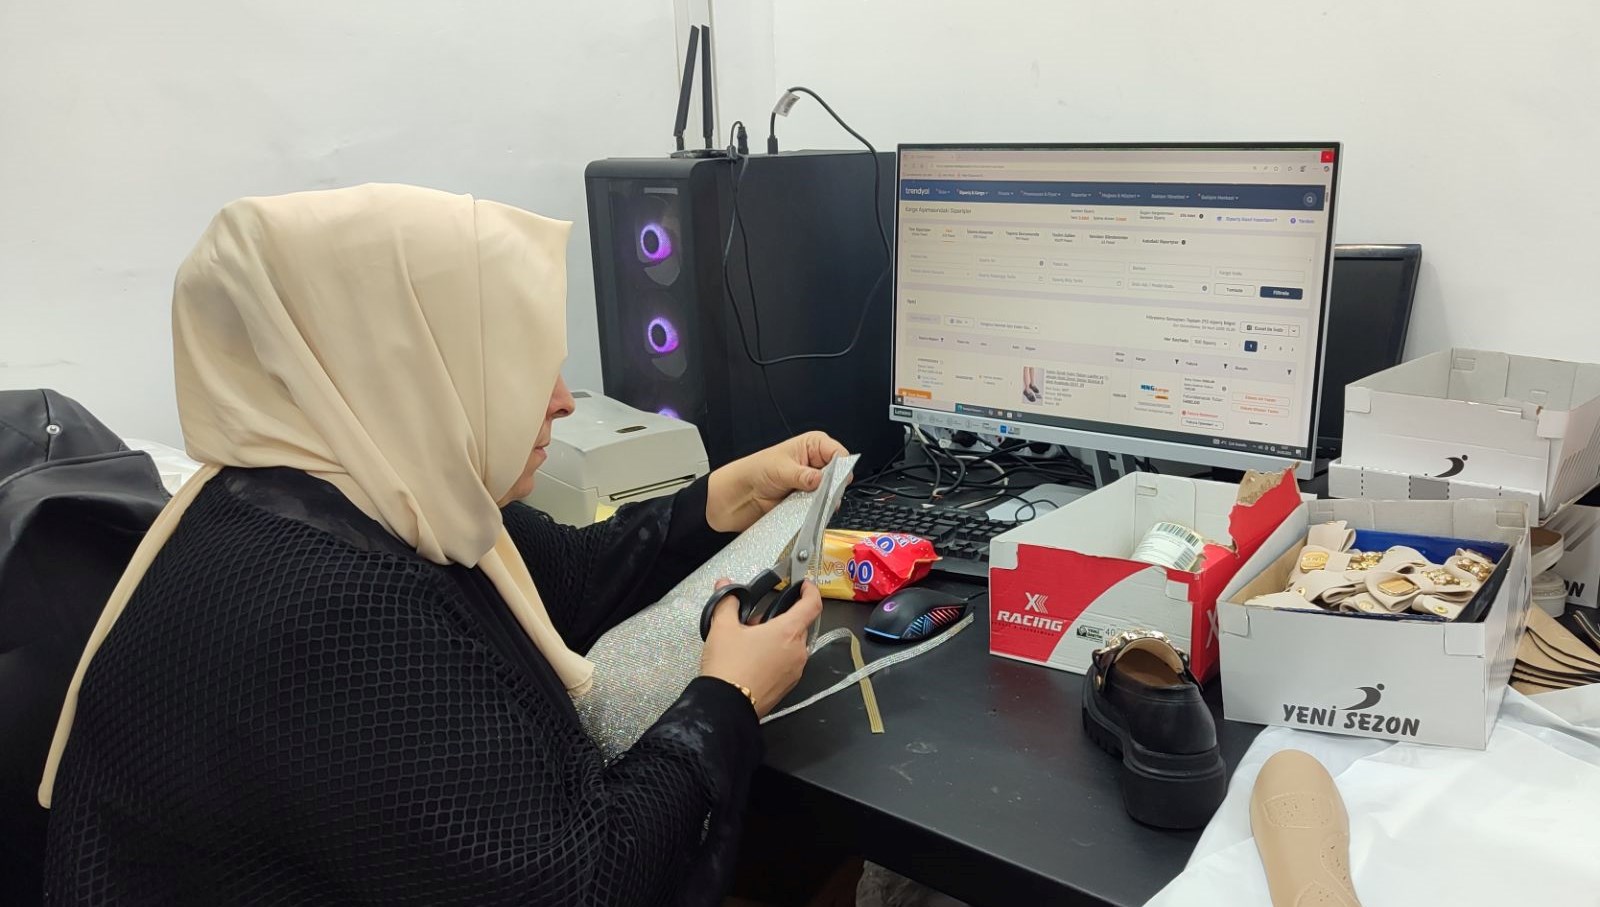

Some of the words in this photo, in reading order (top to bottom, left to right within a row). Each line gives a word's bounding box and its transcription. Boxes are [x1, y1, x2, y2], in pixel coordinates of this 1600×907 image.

[905, 187, 930, 195] trendyol
[997, 611, 1064, 632] RACING
[1283, 704, 1337, 727] YENİ
[1343, 712, 1421, 737] SEZON
